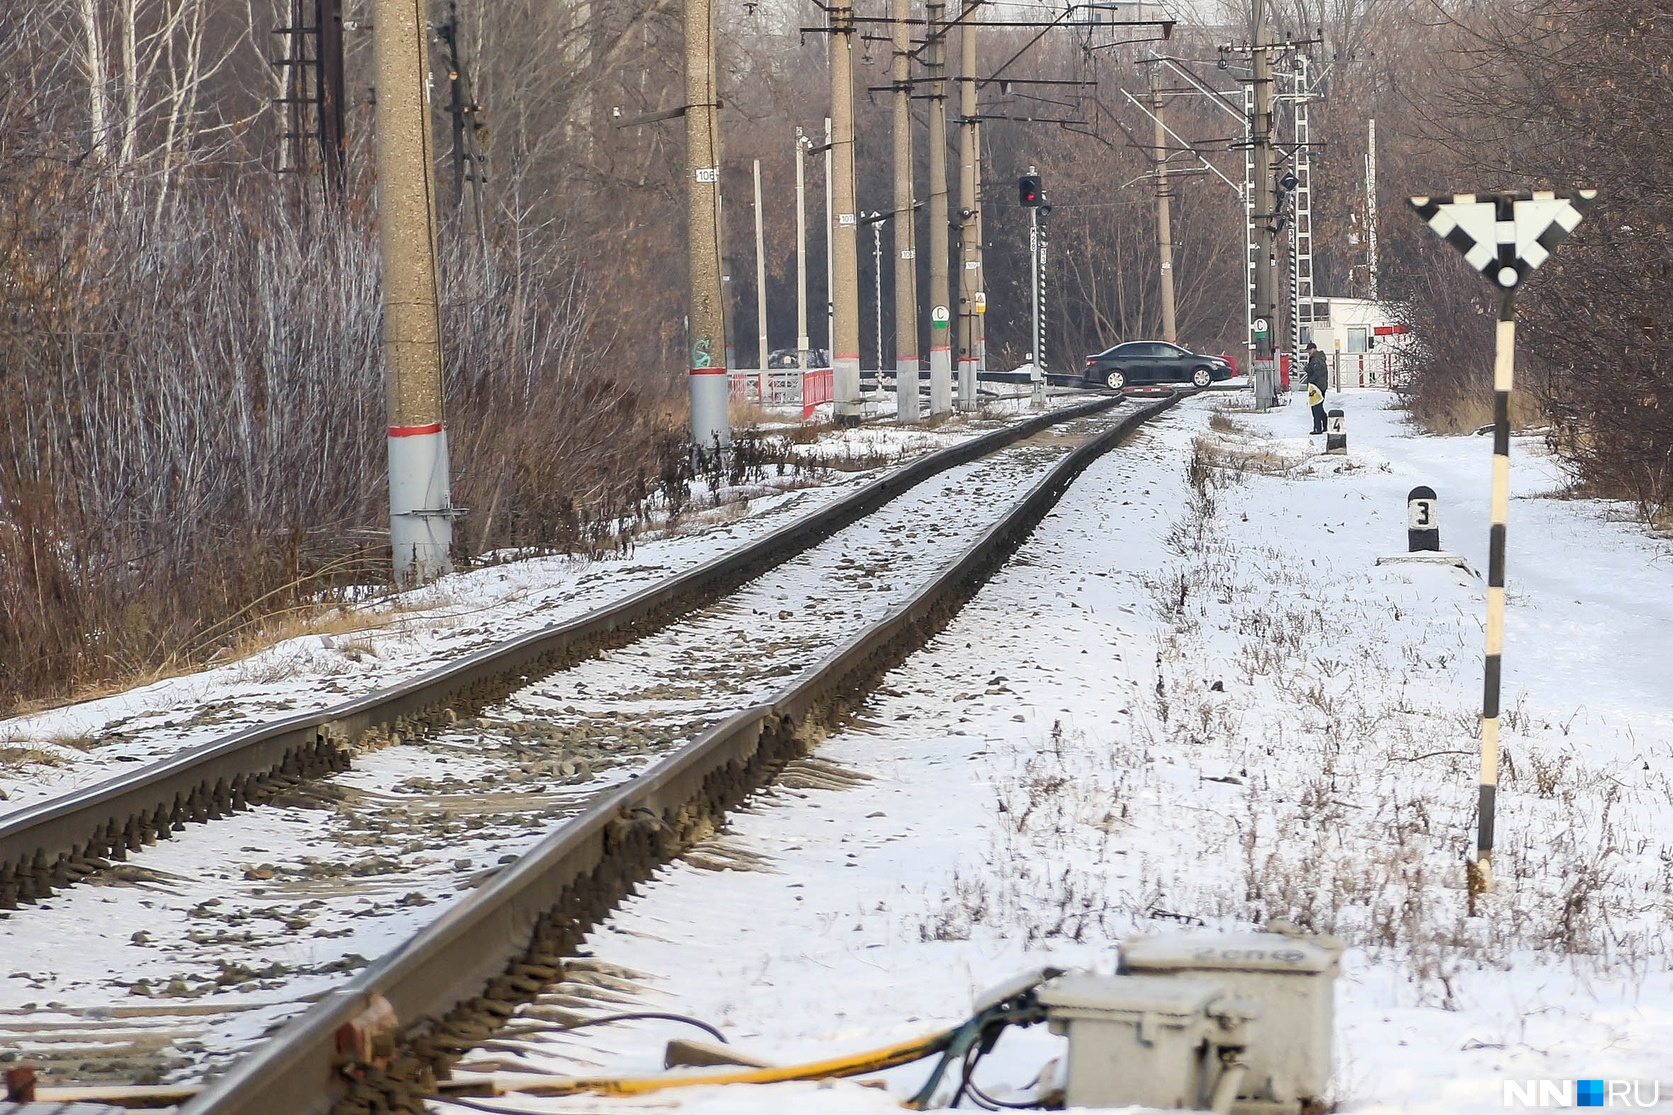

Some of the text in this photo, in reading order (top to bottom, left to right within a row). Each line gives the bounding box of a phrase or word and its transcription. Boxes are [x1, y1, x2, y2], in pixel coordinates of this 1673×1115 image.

[699, 170, 715, 181] 106
[841, 215, 853, 223] 107
[1333, 418, 1341, 432] 4
[1417, 502, 1429, 525] 3
